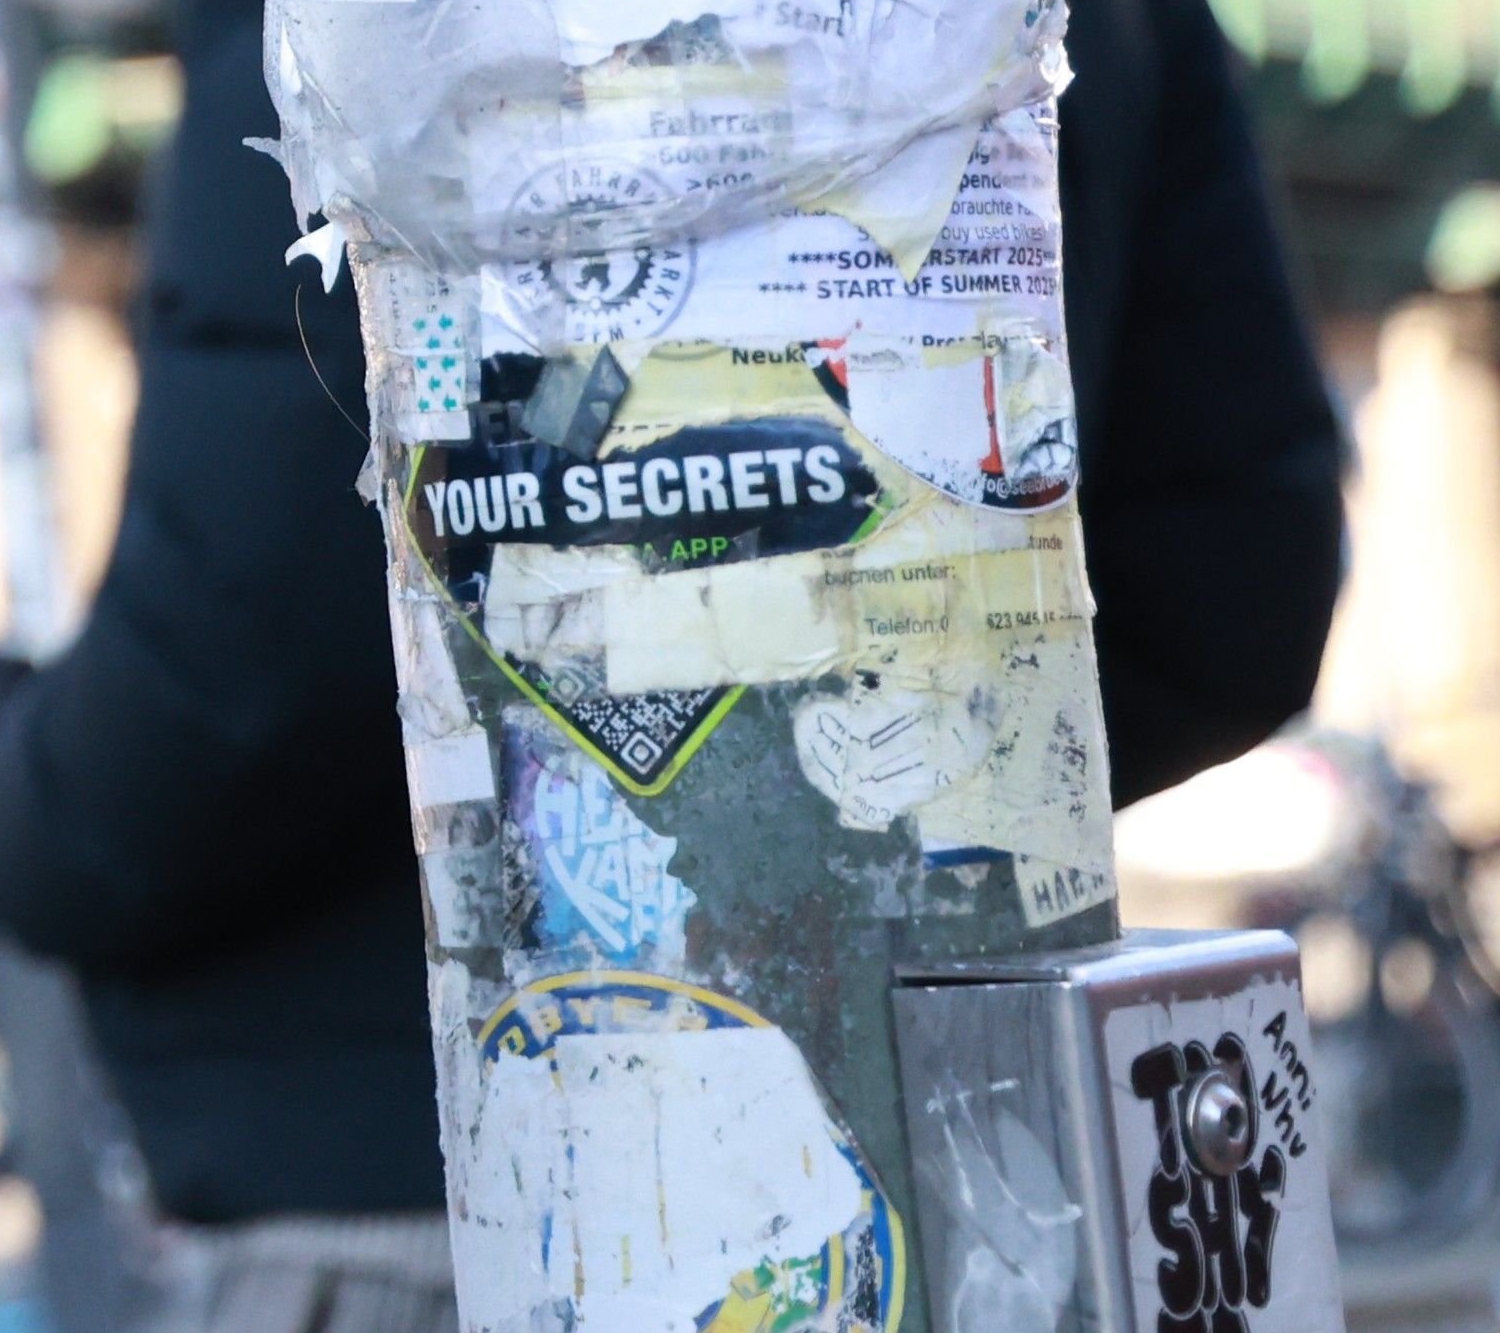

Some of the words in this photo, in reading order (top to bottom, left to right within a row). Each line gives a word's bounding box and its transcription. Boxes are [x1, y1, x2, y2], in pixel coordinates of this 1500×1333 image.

[816, 278, 896, 300] START
[940, 274, 1024, 295] SUMMER
[423, 471, 547, 538] YOUR
[562, 444, 846, 524] SECRETS
